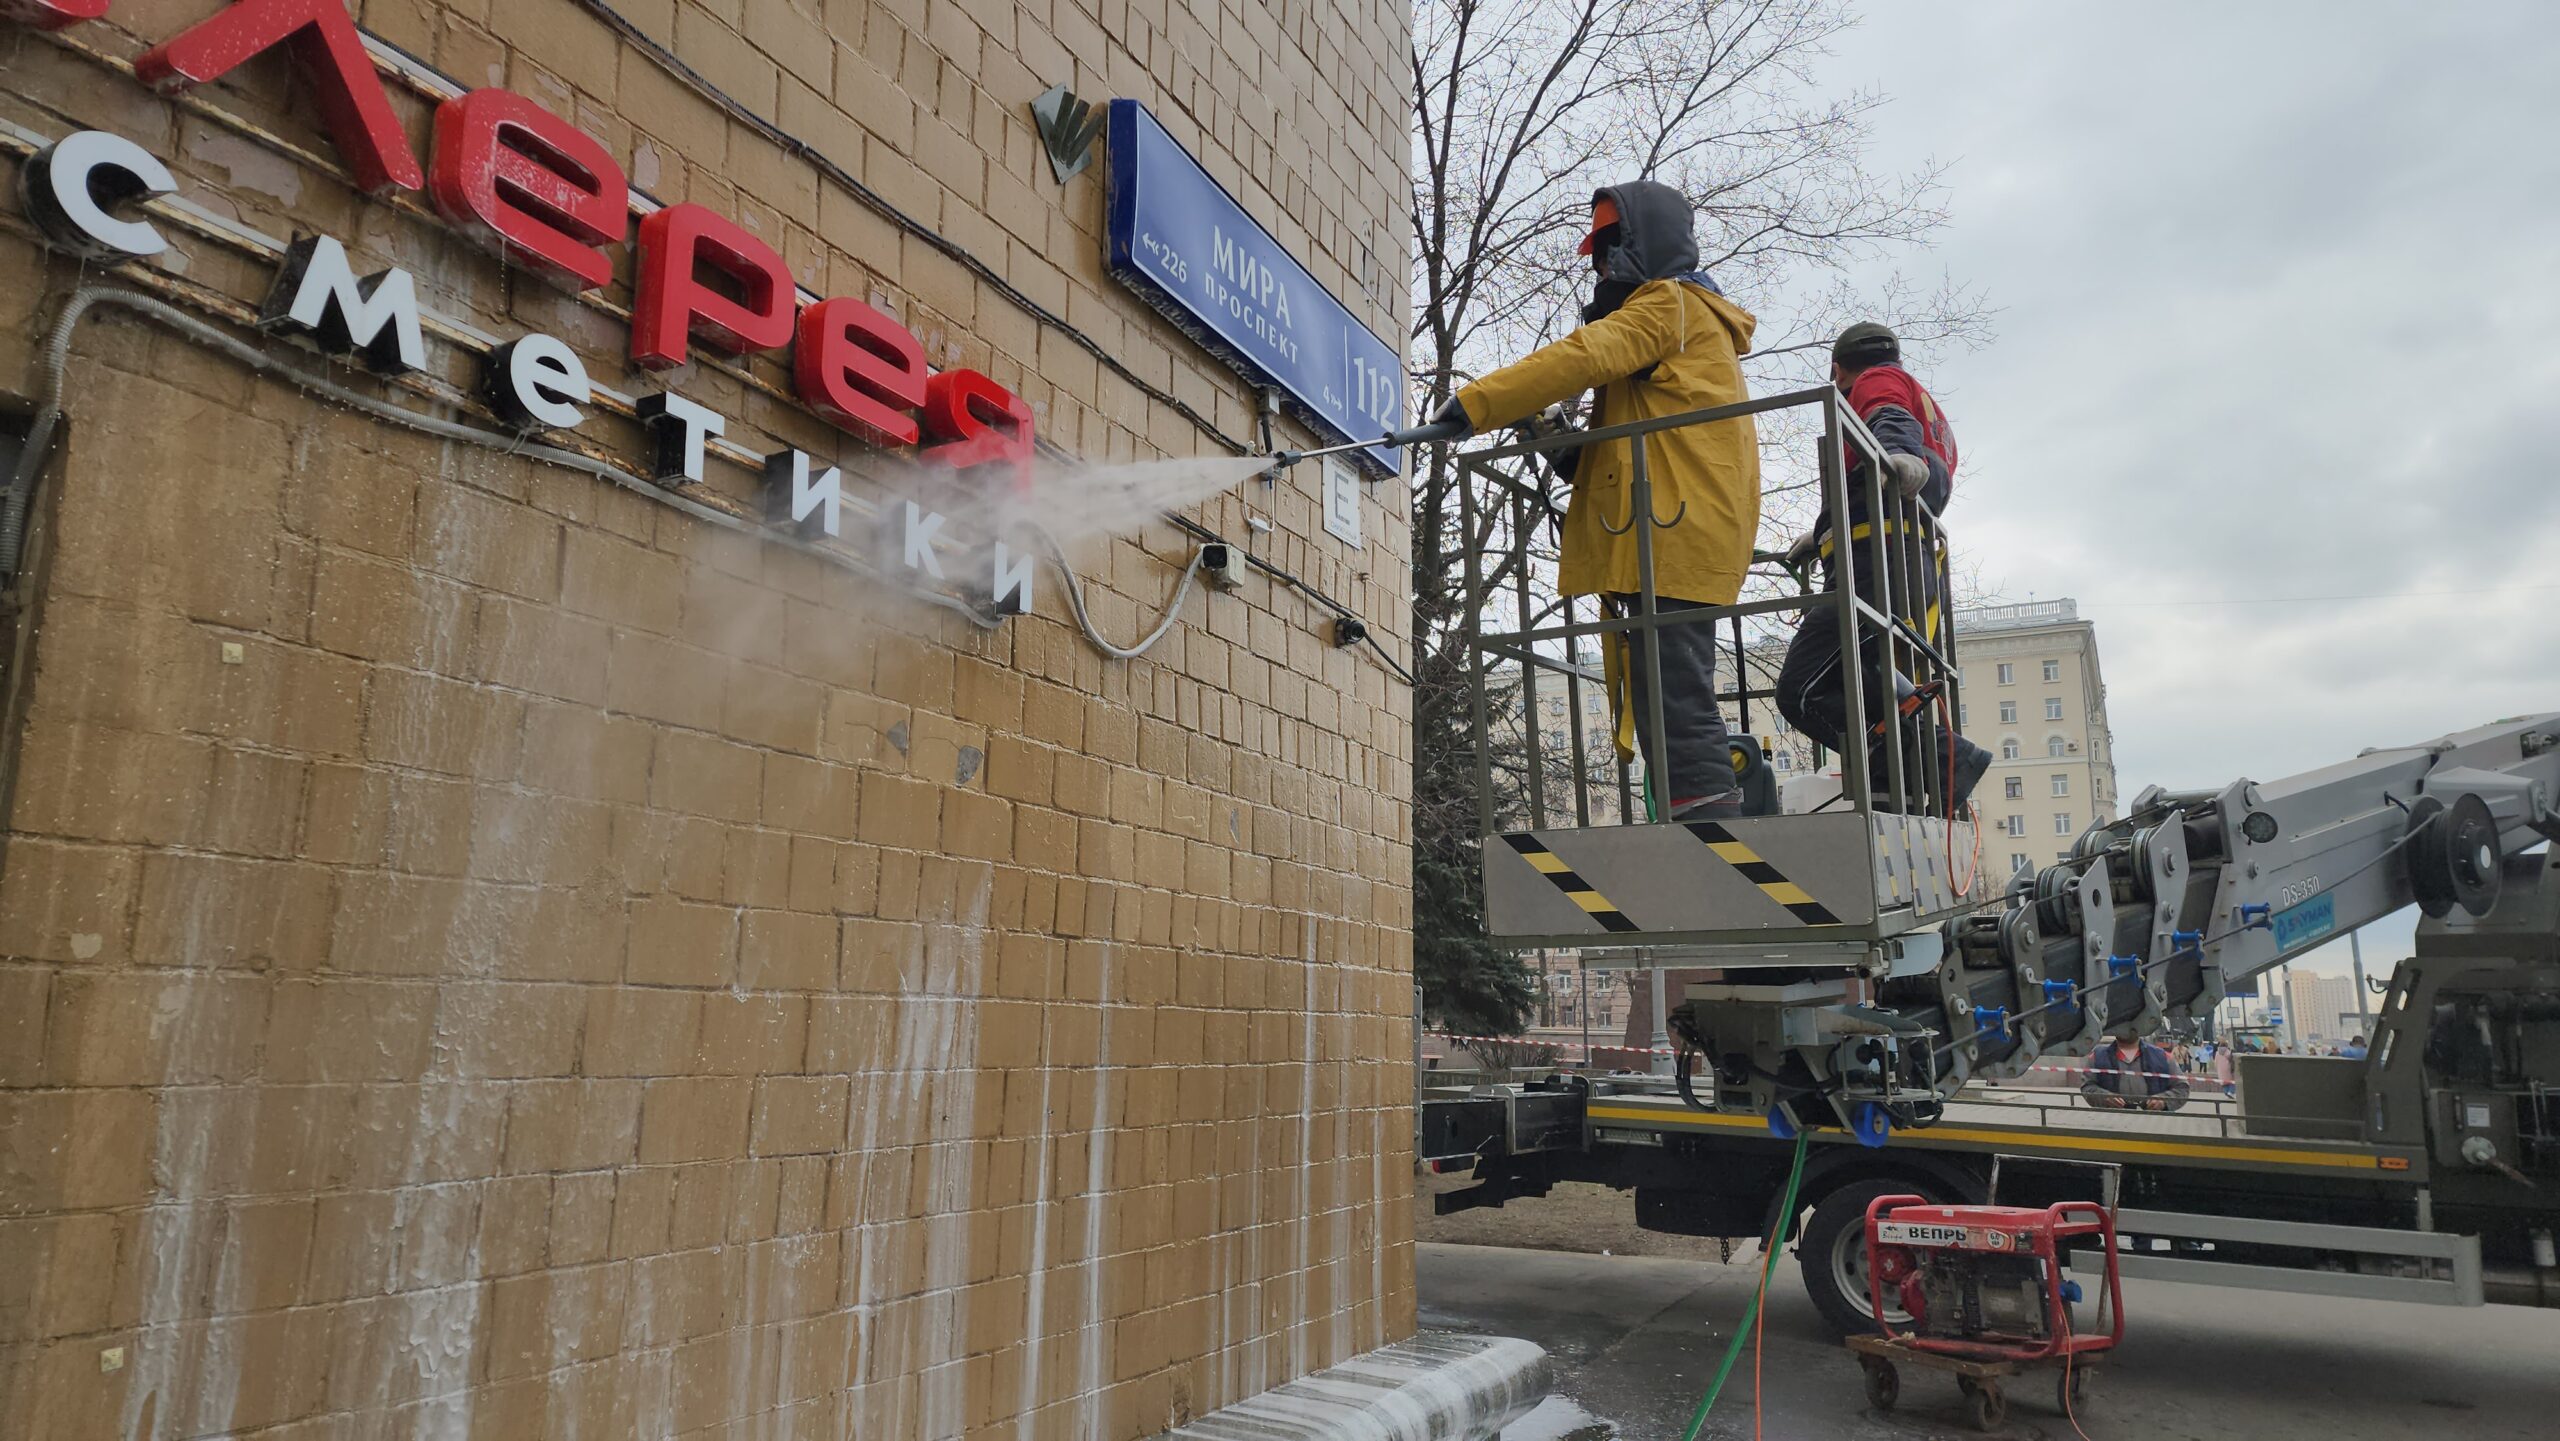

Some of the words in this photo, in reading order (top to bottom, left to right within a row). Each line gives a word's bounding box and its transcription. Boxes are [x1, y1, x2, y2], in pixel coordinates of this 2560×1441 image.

[1160, 243, 1187, 283] 226
[1213, 224, 1292, 330] МИРА
[1204, 271, 1298, 364] ПРОСПЕКТ
[1353, 356, 1395, 432] 112
[2282, 875, 2320, 906] DS-350
[1908, 1226, 1967, 1241] ВЕПРЬ
